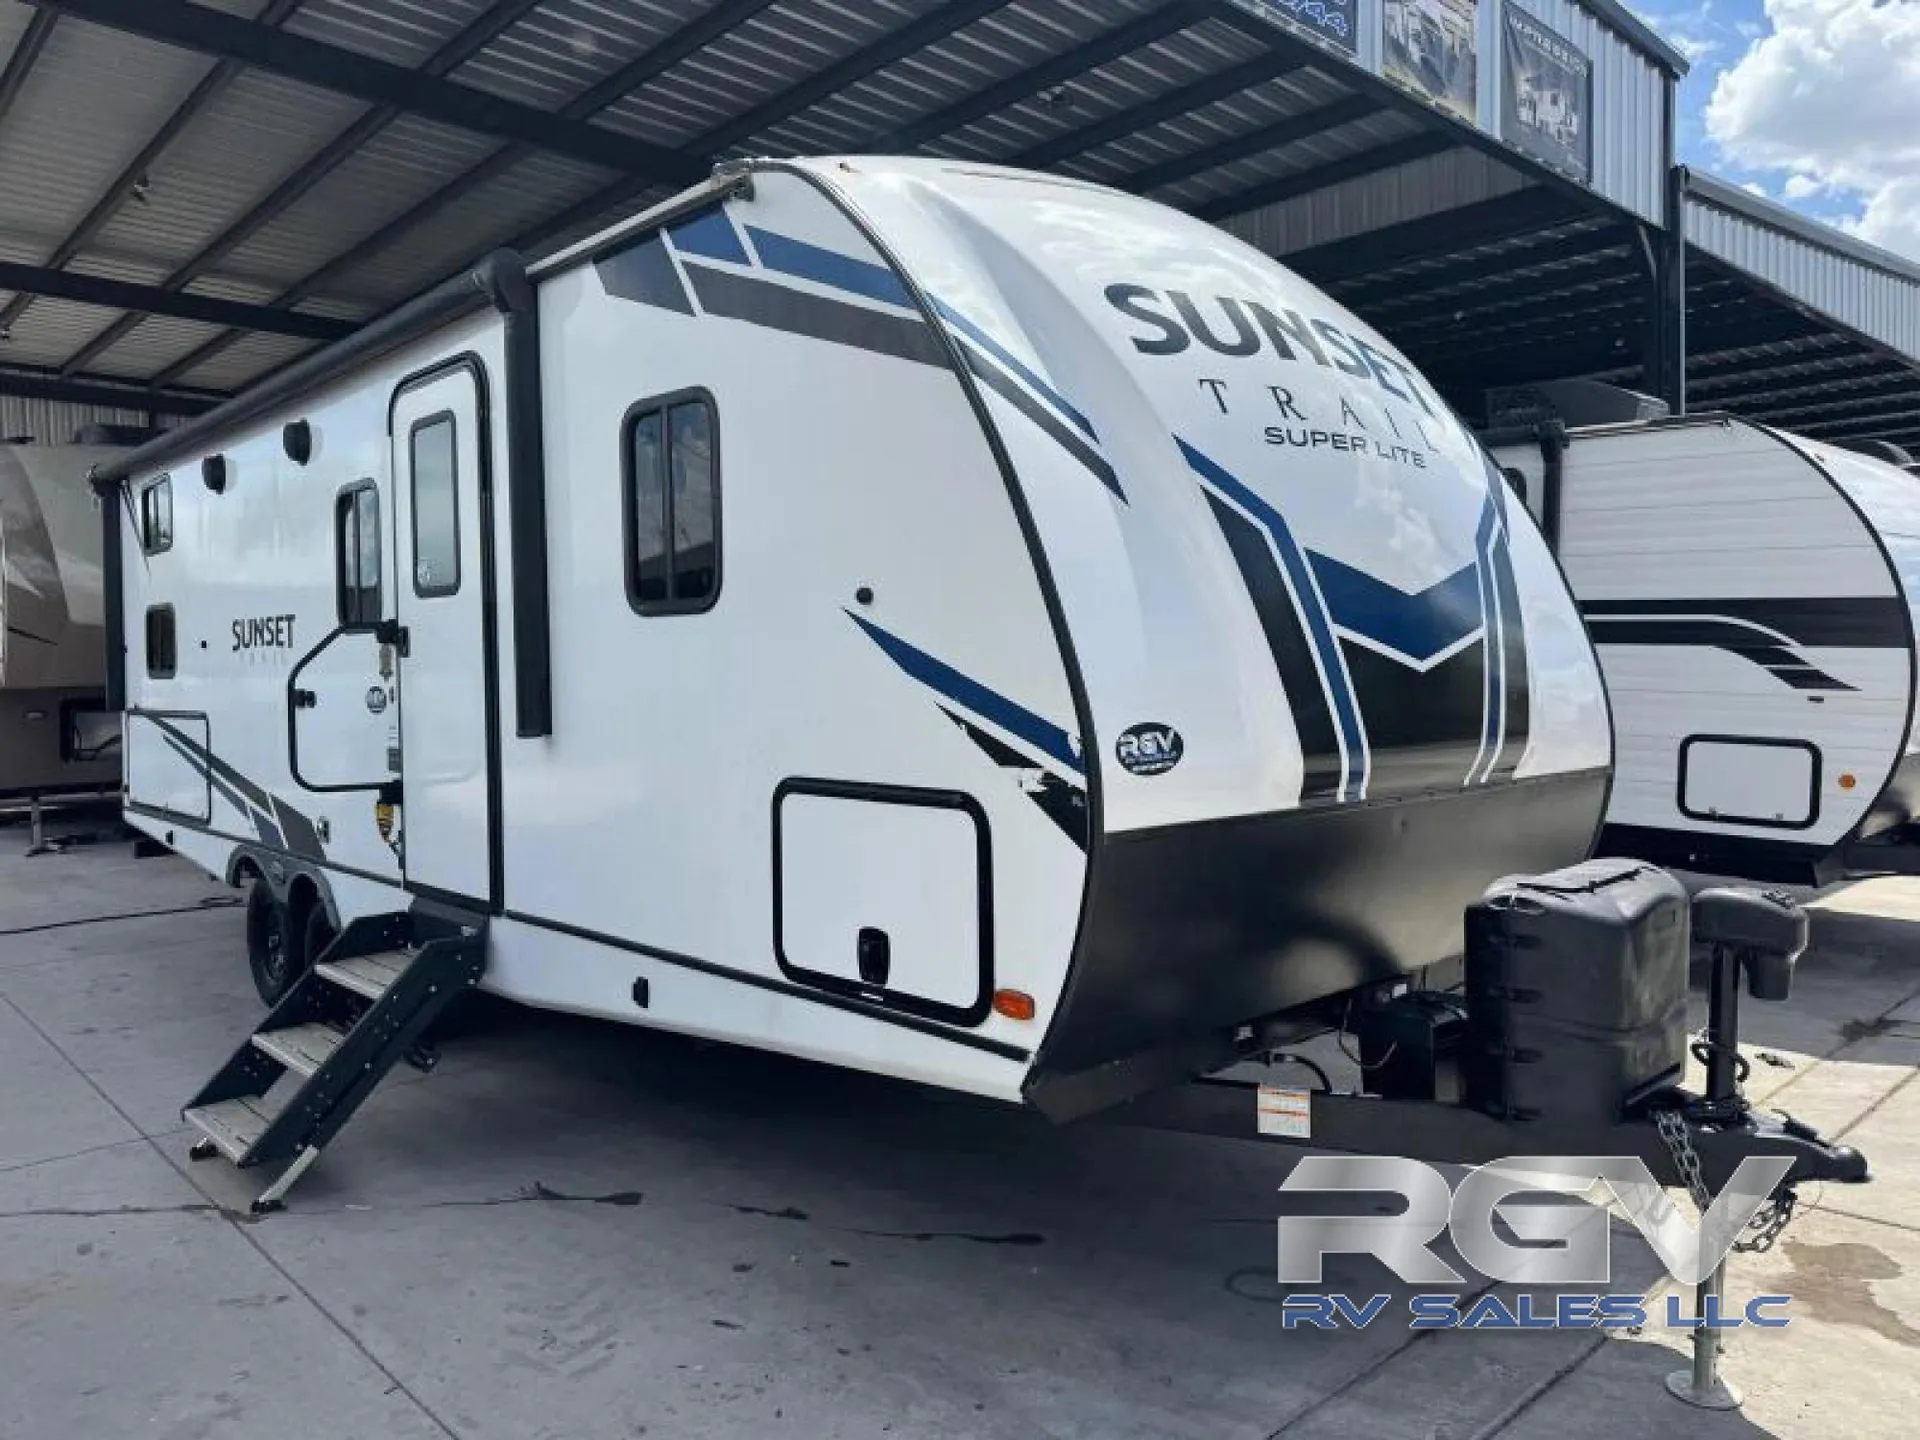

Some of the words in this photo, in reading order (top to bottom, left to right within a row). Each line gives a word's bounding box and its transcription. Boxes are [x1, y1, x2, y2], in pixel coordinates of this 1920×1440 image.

[1104, 283, 1437, 419] SUNSET
[1199, 379, 1440, 454] TRAIL
[1264, 427, 1367, 453] SUPER
[1375, 441, 1427, 469] LITE
[232, 614, 296, 652] SUNSET
